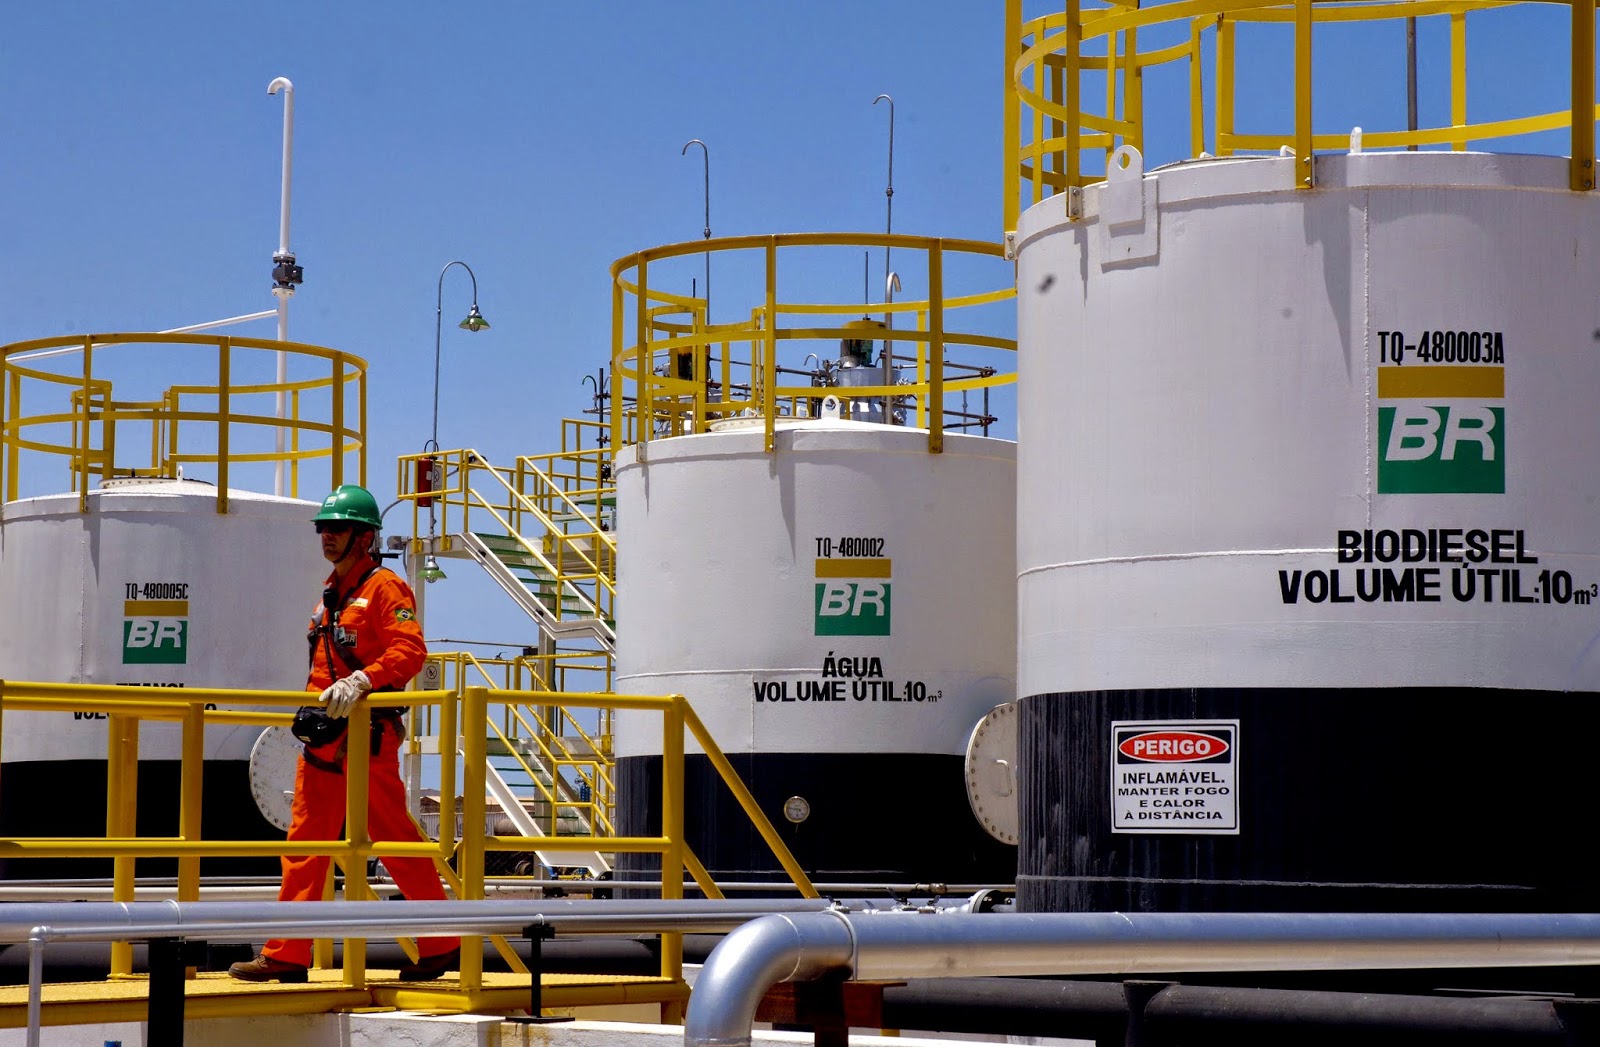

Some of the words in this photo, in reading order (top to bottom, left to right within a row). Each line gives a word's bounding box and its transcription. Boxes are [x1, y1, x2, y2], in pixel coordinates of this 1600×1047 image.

[1377, 331, 1504, 365] TQ-480003A
[1385, 406, 1496, 461] BR
[815, 537, 884, 558] TQ-480002
[1337, 529, 1538, 564] BIODIESEL
[125, 582, 189, 600] TQ-480005C
[1278, 568, 1441, 604] VOLUME
[819, 583, 885, 616] BR
[126, 620, 183, 648] BR
[822, 651, 883, 678] ÁGUA
[754, 681, 846, 702] VOLUME
[1134, 739, 1211, 755] PERIGO
[1123, 769, 1225, 784] INFLAMÁVEL.
[1118, 787, 1179, 796] MANTER
[1184, 786, 1230, 796] FOGO
[1139, 799, 1148, 808] E
[1153, 799, 1205, 808] CALOR
[1124, 810, 1134, 820] À
[1138, 810, 1223, 820] DISTÂNCIA
